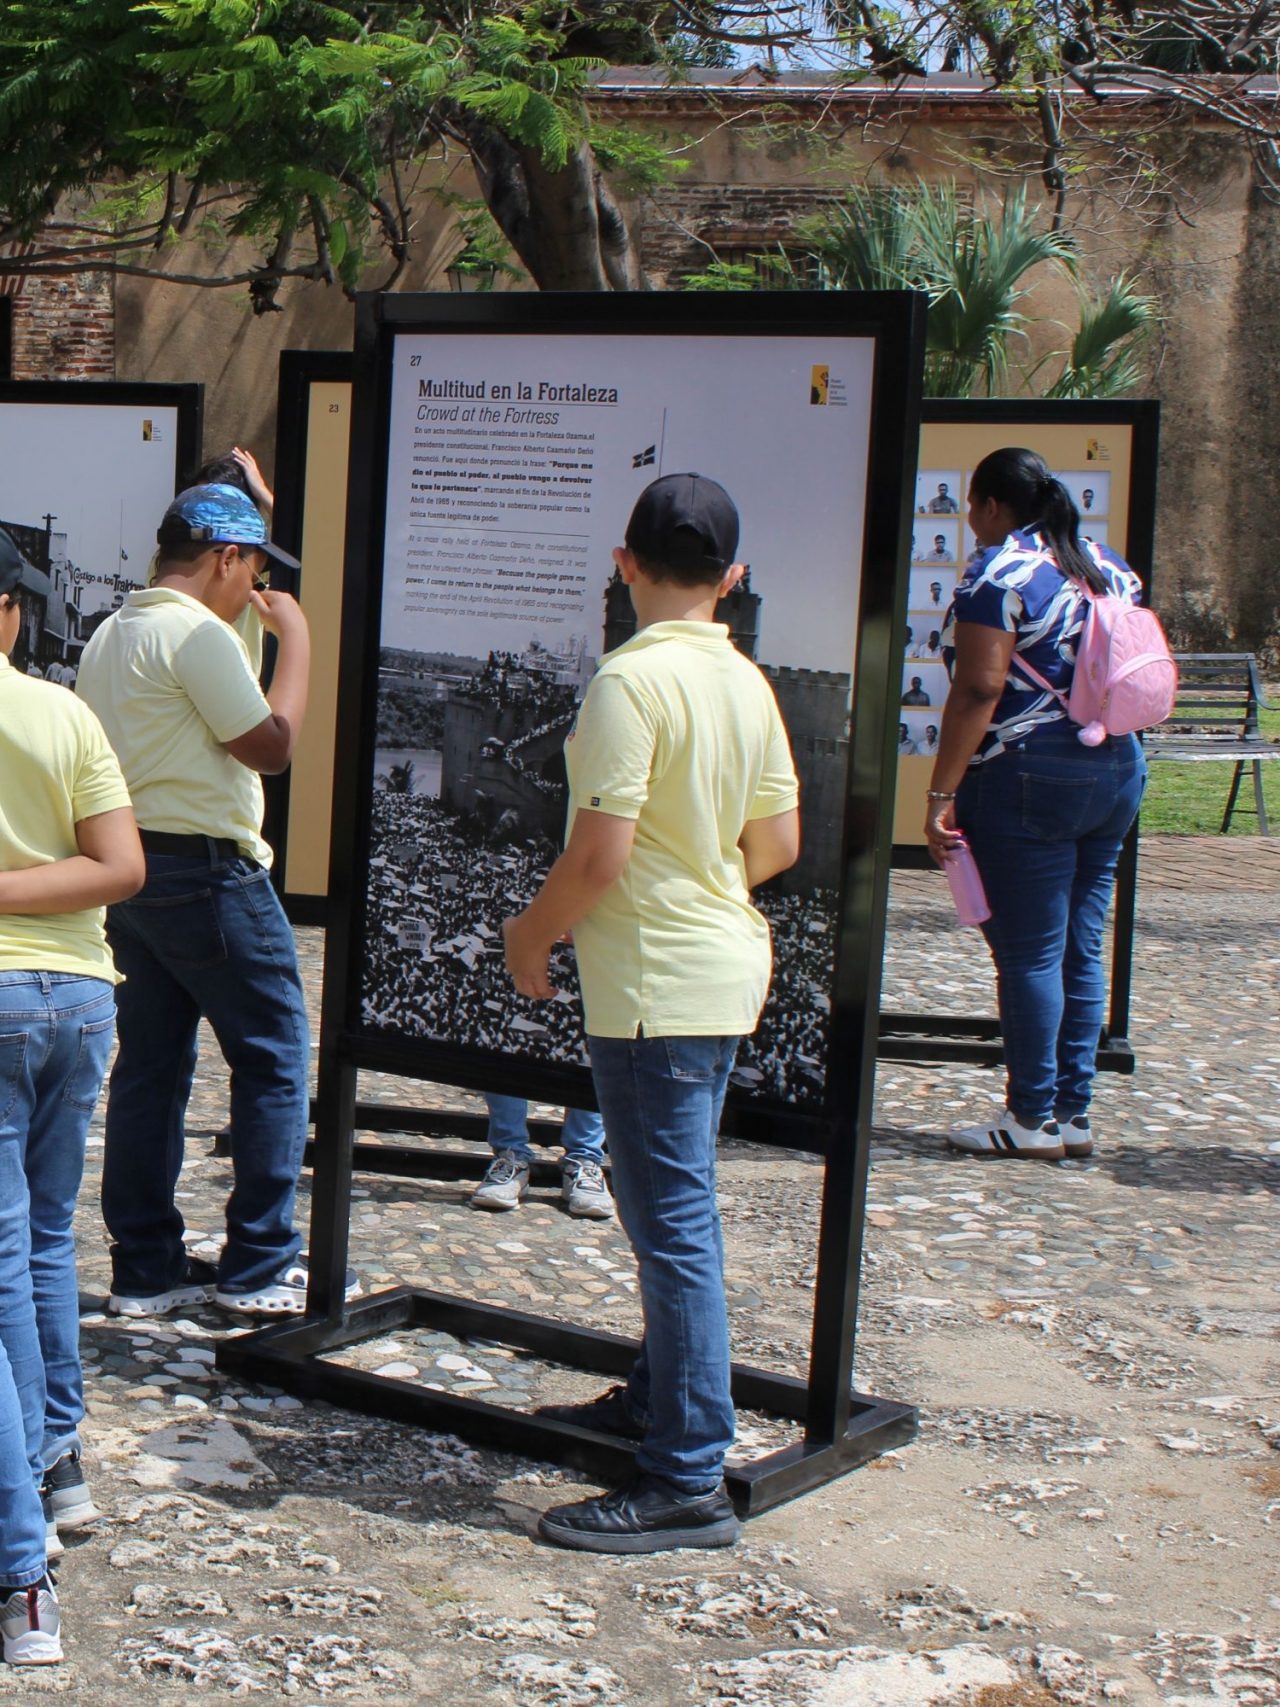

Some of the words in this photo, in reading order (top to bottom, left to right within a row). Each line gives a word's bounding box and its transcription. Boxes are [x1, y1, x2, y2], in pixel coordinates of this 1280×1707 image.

[410, 355, 421, 367] 27
[418, 379, 486, 398] Multitud
[491, 385, 511, 400] en
[517, 382, 532, 400] la
[538, 382, 618, 402] Fortaleza
[329, 404, 339, 413] 23
[417, 404, 460, 421] Crowd
[462, 407, 476, 422] at
[478, 407, 501, 423] the
[504, 408, 560, 425] Fortress
[529, 430, 534, 438] la
[412, 468, 424, 476] dio
[434, 470, 458, 478] pueblo
[528, 474, 551, 483] vengo
[560, 476, 592, 484] devolver
[420, 484, 433, 492] que
[532, 488, 540, 496] de
[410, 496, 424, 504] Abril
[540, 504, 563, 512] popular
[536, 572, 558, 580] people
